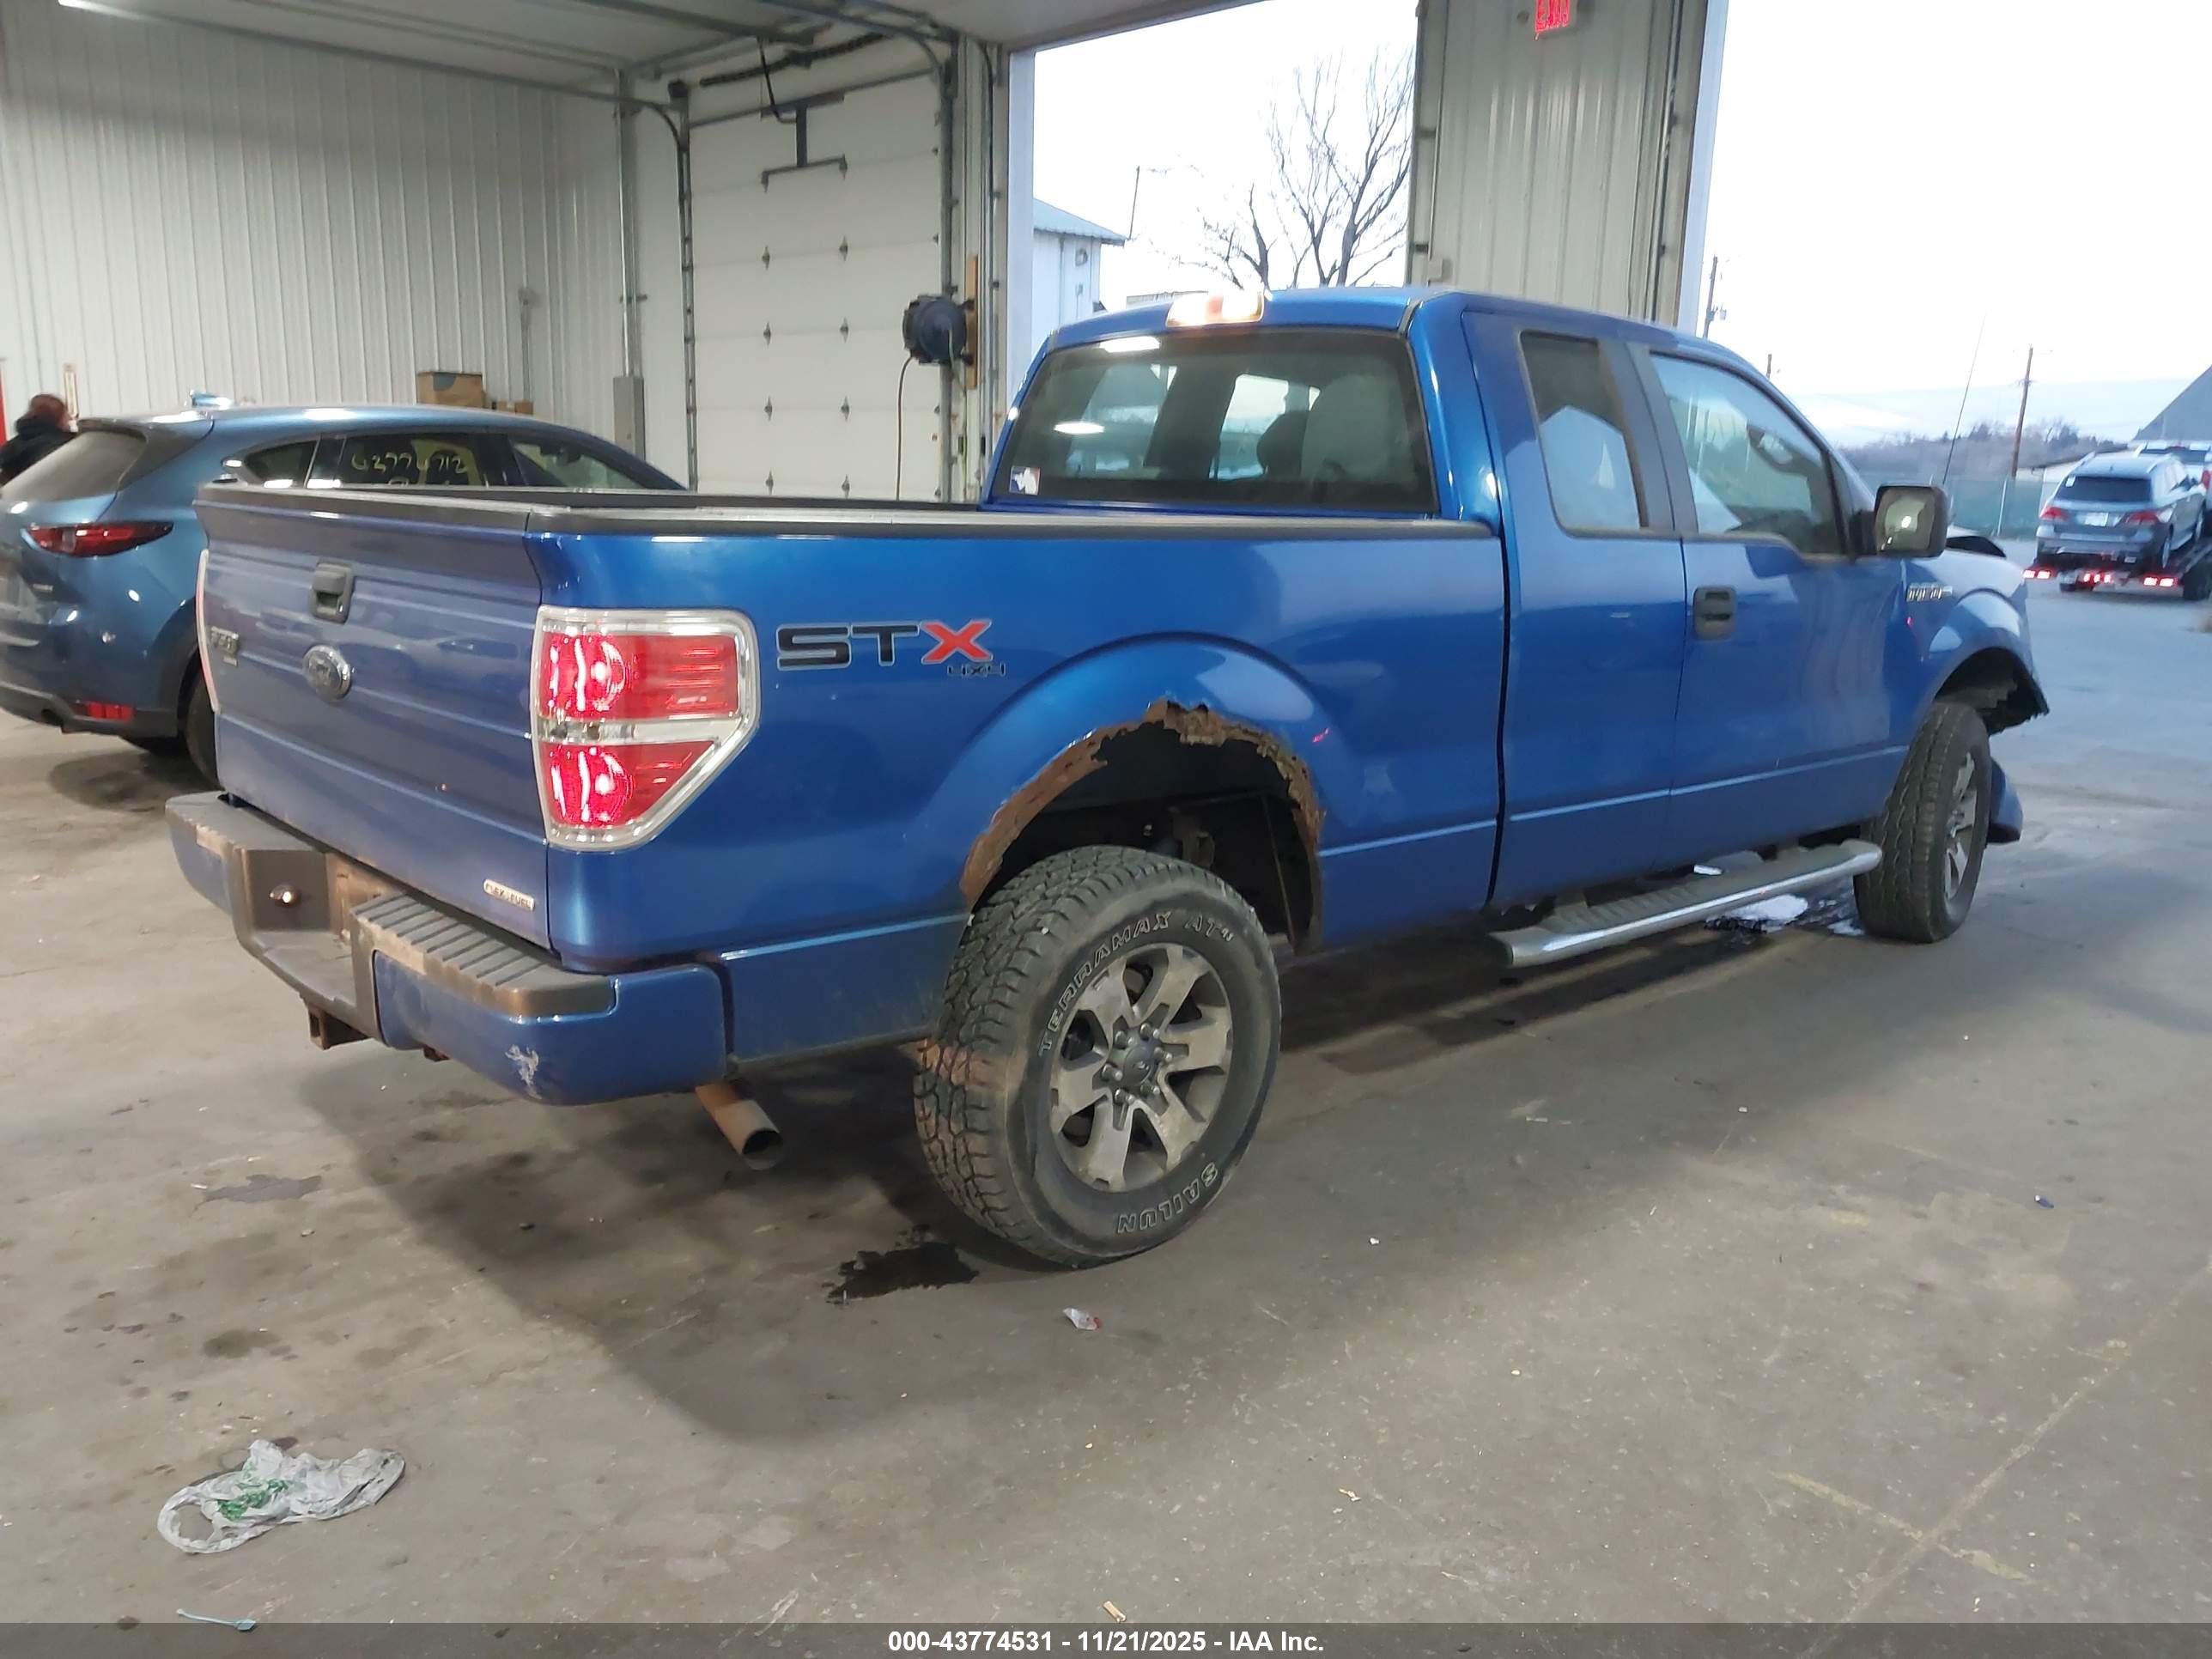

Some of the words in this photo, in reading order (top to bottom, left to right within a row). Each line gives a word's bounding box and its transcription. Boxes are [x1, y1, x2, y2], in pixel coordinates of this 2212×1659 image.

[776, 618, 994, 672] STX
[1038, 911, 1173, 1057] TERRAMAX
[1116, 1162, 1219, 1235] SAILUN
